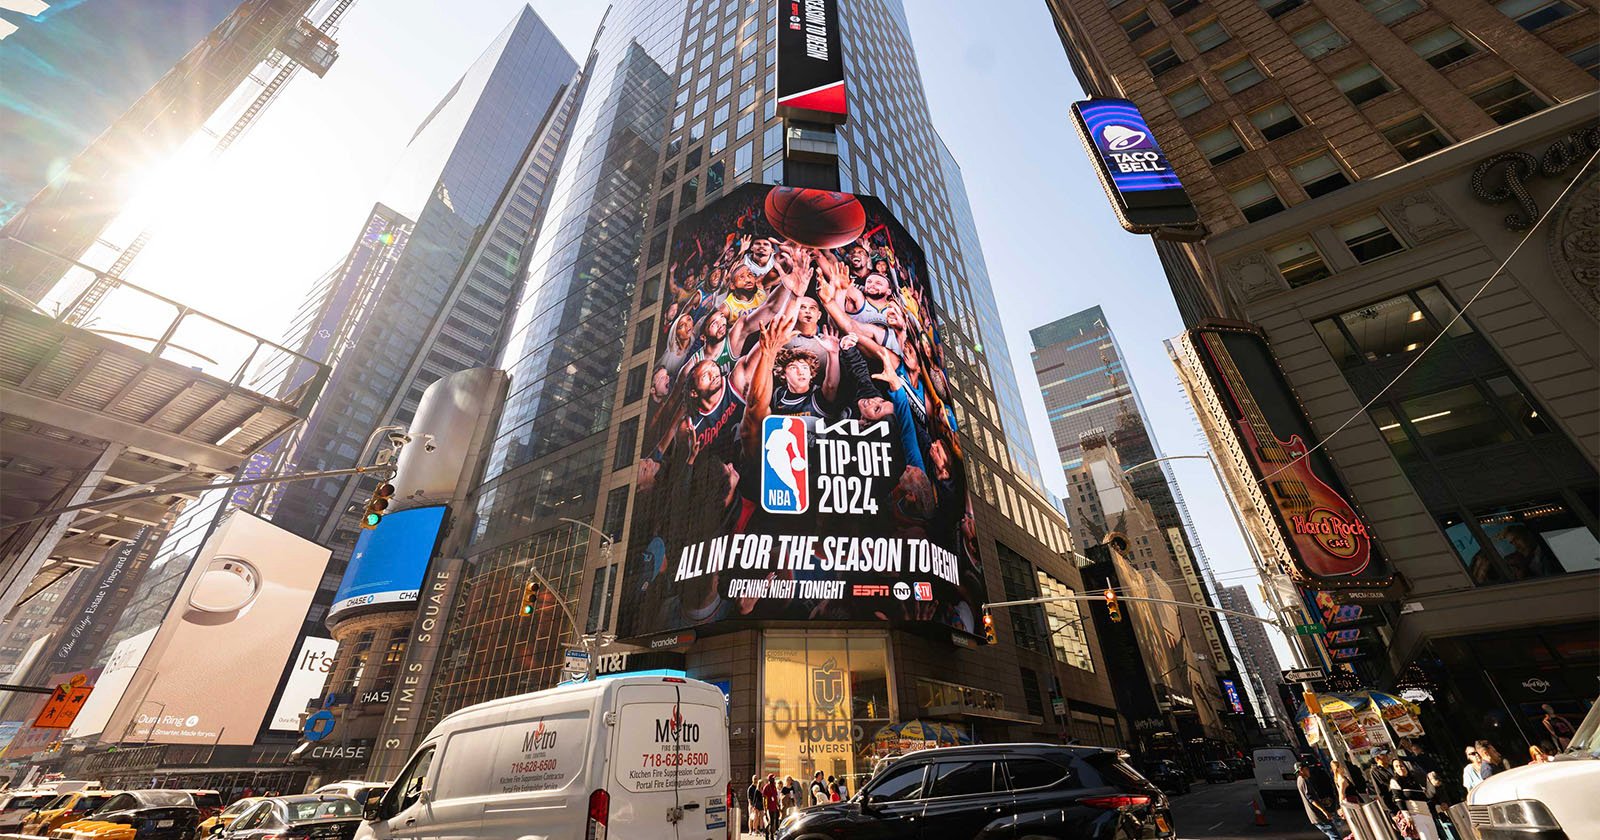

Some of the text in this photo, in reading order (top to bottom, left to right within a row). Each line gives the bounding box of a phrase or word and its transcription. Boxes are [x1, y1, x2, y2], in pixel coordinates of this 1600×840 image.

[806, 23, 826, 36] TO
[806, 33, 829, 61] BEGIN
[1109, 151, 1159, 163] TACO
[1117, 161, 1167, 174] BELL
[696, 401, 738, 451] Clippers
[768, 489, 791, 506] NBA
[817, 474, 879, 515] 2024
[1292, 515, 1370, 540] Hard Rock
[674, 533, 960, 587] ALL IN FOR THE SEASON TO BEGIN
[1170, 533, 1198, 587] HOTEL
[399, 592, 419, 600] CHA
[728, 578, 769, 599] OPENING
[768, 579, 798, 599] NIGHT
[798, 580, 847, 600] TONIGHT
[852, 584, 890, 597] ESPN
[893, 587, 911, 596] TNT
[58, 638, 76, 658] Blue
[71, 615, 93, 638] Ridge
[84, 590, 106, 615] Estate
[100, 556, 128, 593] Vineyard
[121, 548, 133, 557] &
[346, 596, 368, 607] CHASE
[1303, 625, 1309, 634] 7
[651, 635, 678, 649] branded
[300, 649, 334, 673] It's
[385, 571, 450, 749] 3 TIMES SQUARE
[595, 651, 631, 674] AT&T
[138, 713, 185, 727] Oura Ring
[655, 719, 700, 743] Metro
[797, 724, 864, 743] TOURO
[522, 729, 557, 752] Metro
[799, 743, 863, 755] UNIVERSITY
[312, 746, 367, 759] CHASE
[642, 752, 709, 768] 718-628-6500
[511, 759, 557, 774] 718-628-6500
[629, 769, 652, 779] Kitchen
[652, 768, 664, 778] Fire
[693, 766, 716, 776] Contractor
[636, 780, 653, 790] Portal
[653, 779, 664, 789] Fire
[696, 777, 711, 787] Service
